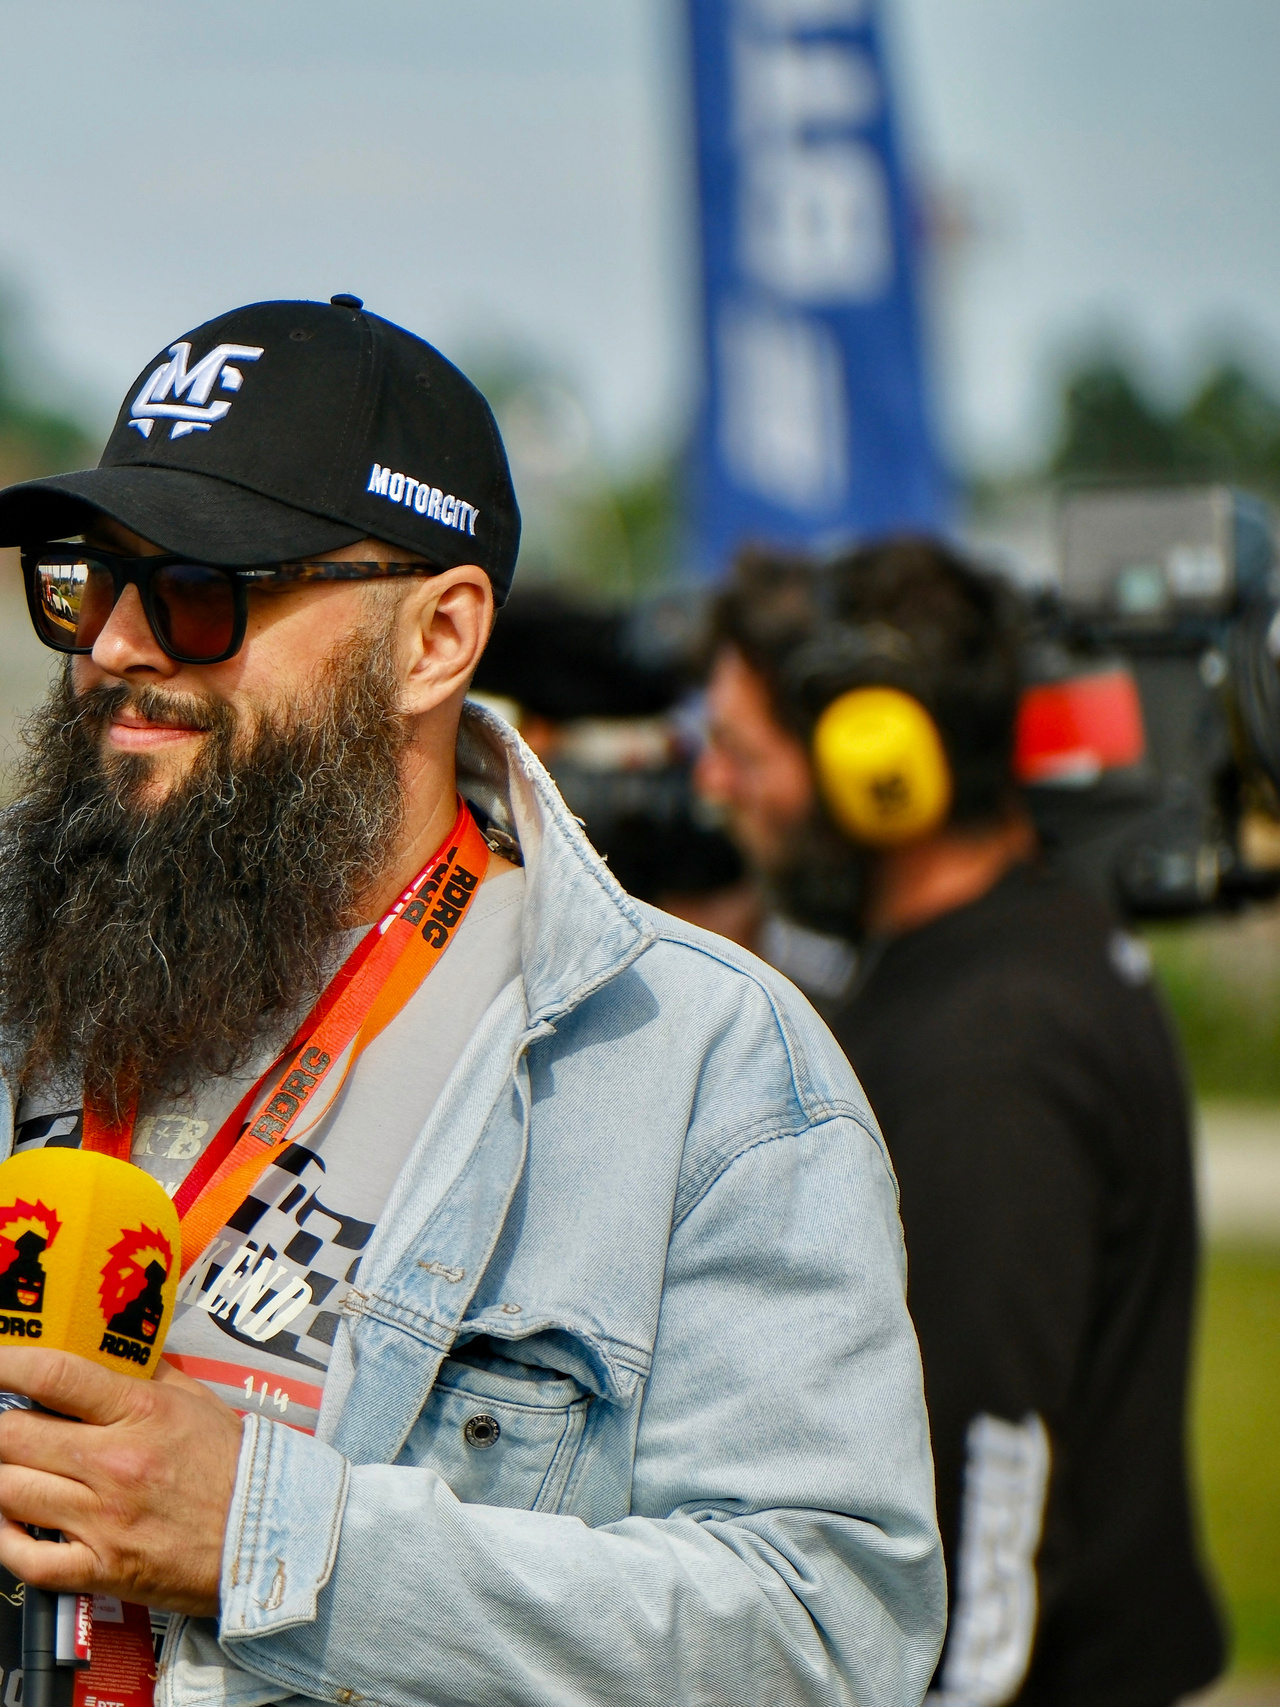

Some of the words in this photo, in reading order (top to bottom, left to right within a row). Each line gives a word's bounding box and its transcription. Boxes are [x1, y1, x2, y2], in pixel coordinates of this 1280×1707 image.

[367, 463, 480, 536] MOTORCITY
[422, 864, 479, 949] RDRC
[249, 1046, 331, 1147] RDRC
[99, 1332, 152, 1366] RDRC
